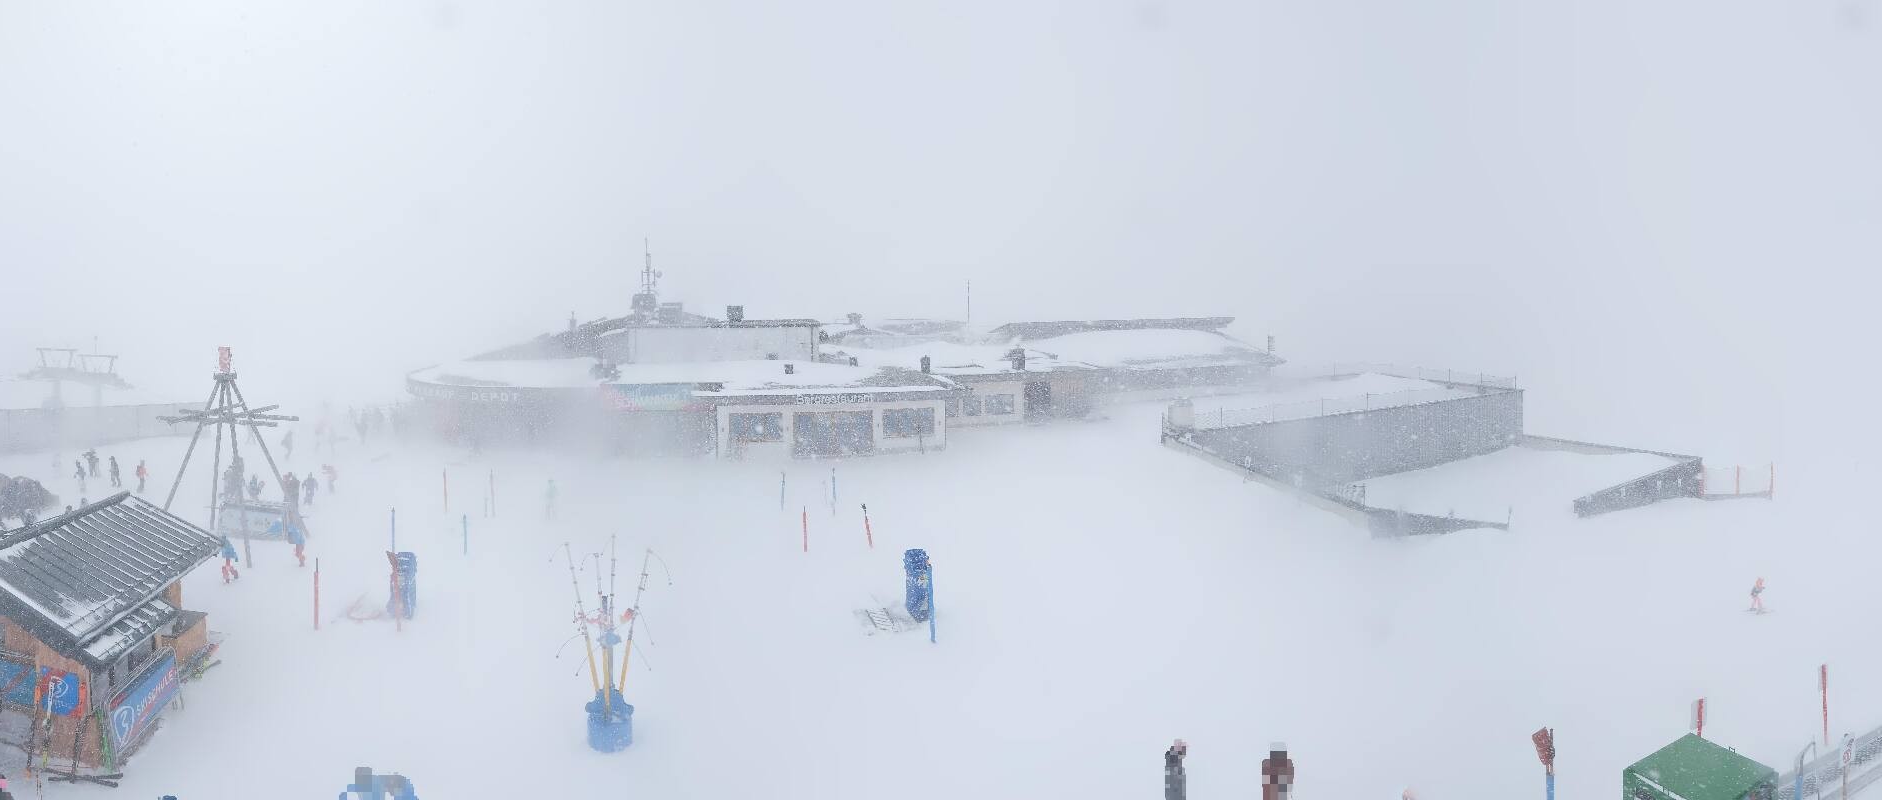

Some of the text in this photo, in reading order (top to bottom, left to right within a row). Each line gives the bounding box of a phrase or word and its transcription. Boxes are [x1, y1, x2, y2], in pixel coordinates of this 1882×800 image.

[471, 391, 519, 401] DEPOT
[796, 393, 873, 406] Bergrestaurant
[135, 669, 173, 716] SKISCHULE
